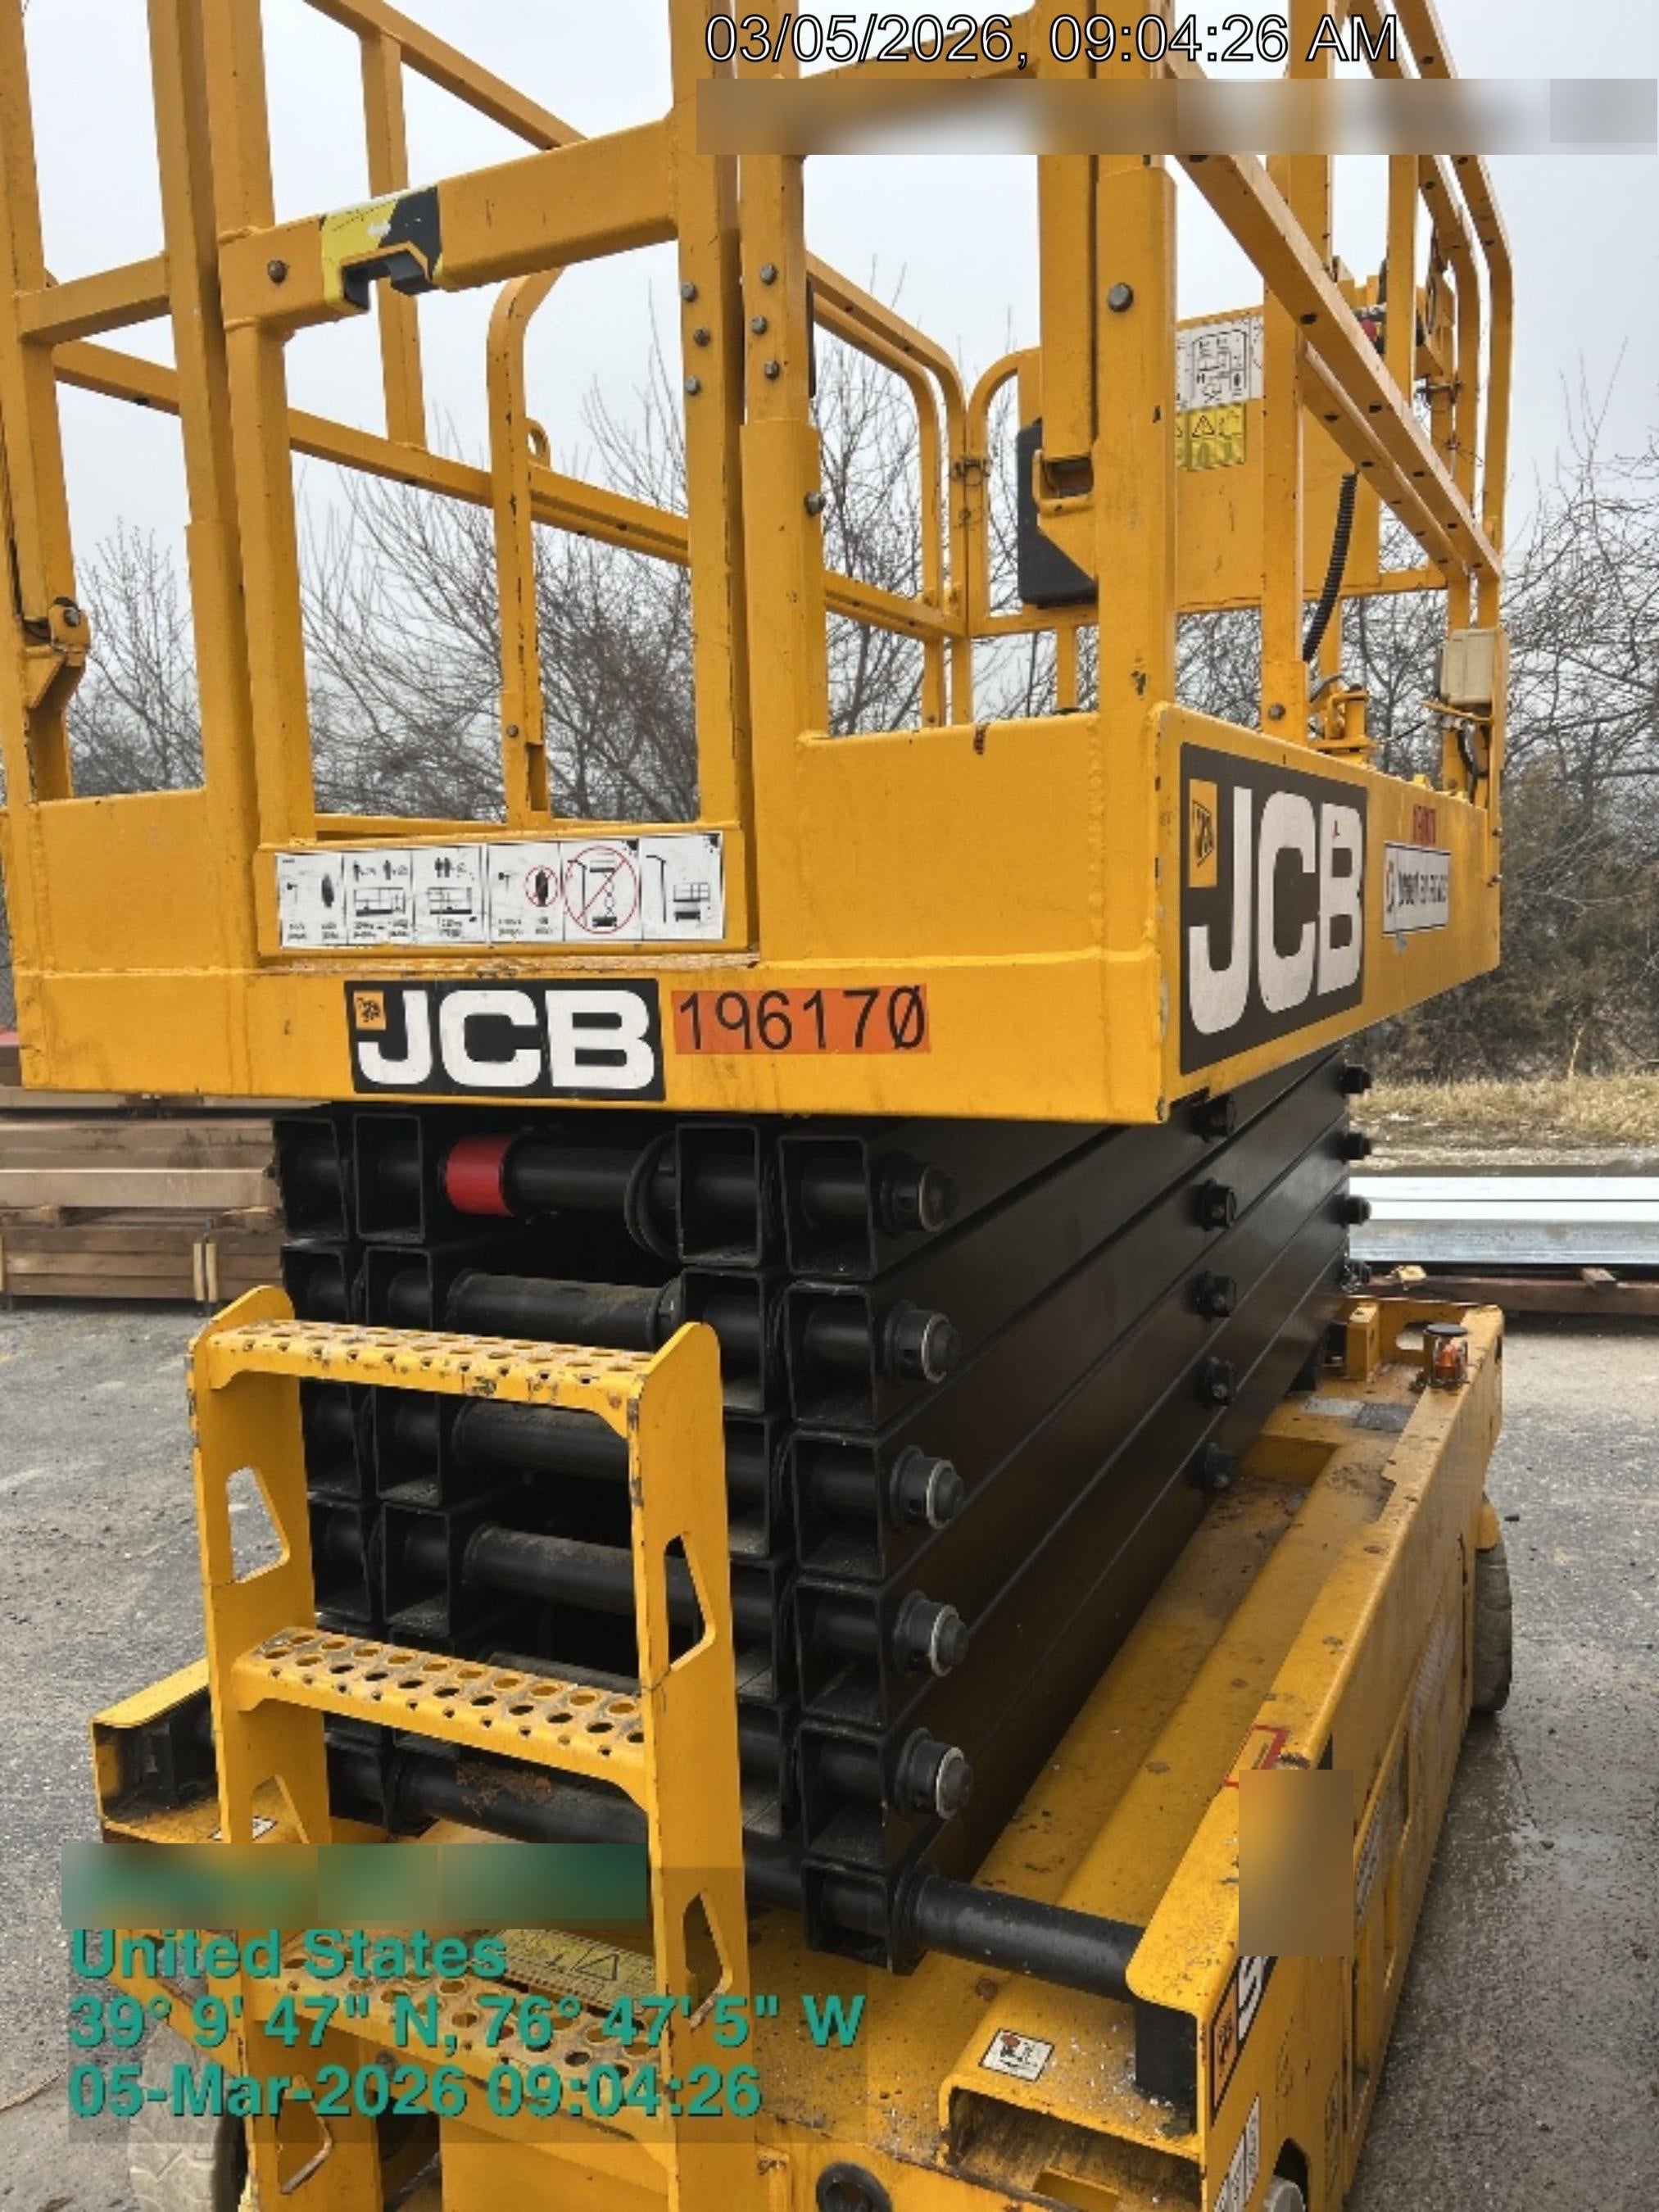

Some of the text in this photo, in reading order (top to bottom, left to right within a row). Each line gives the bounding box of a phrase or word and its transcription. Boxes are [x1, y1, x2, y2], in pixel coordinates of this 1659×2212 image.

[1189, 786, 1362, 1035] JCB
[358, 989, 655, 1090] JCB
[680, 984, 927, 1050] 196170
